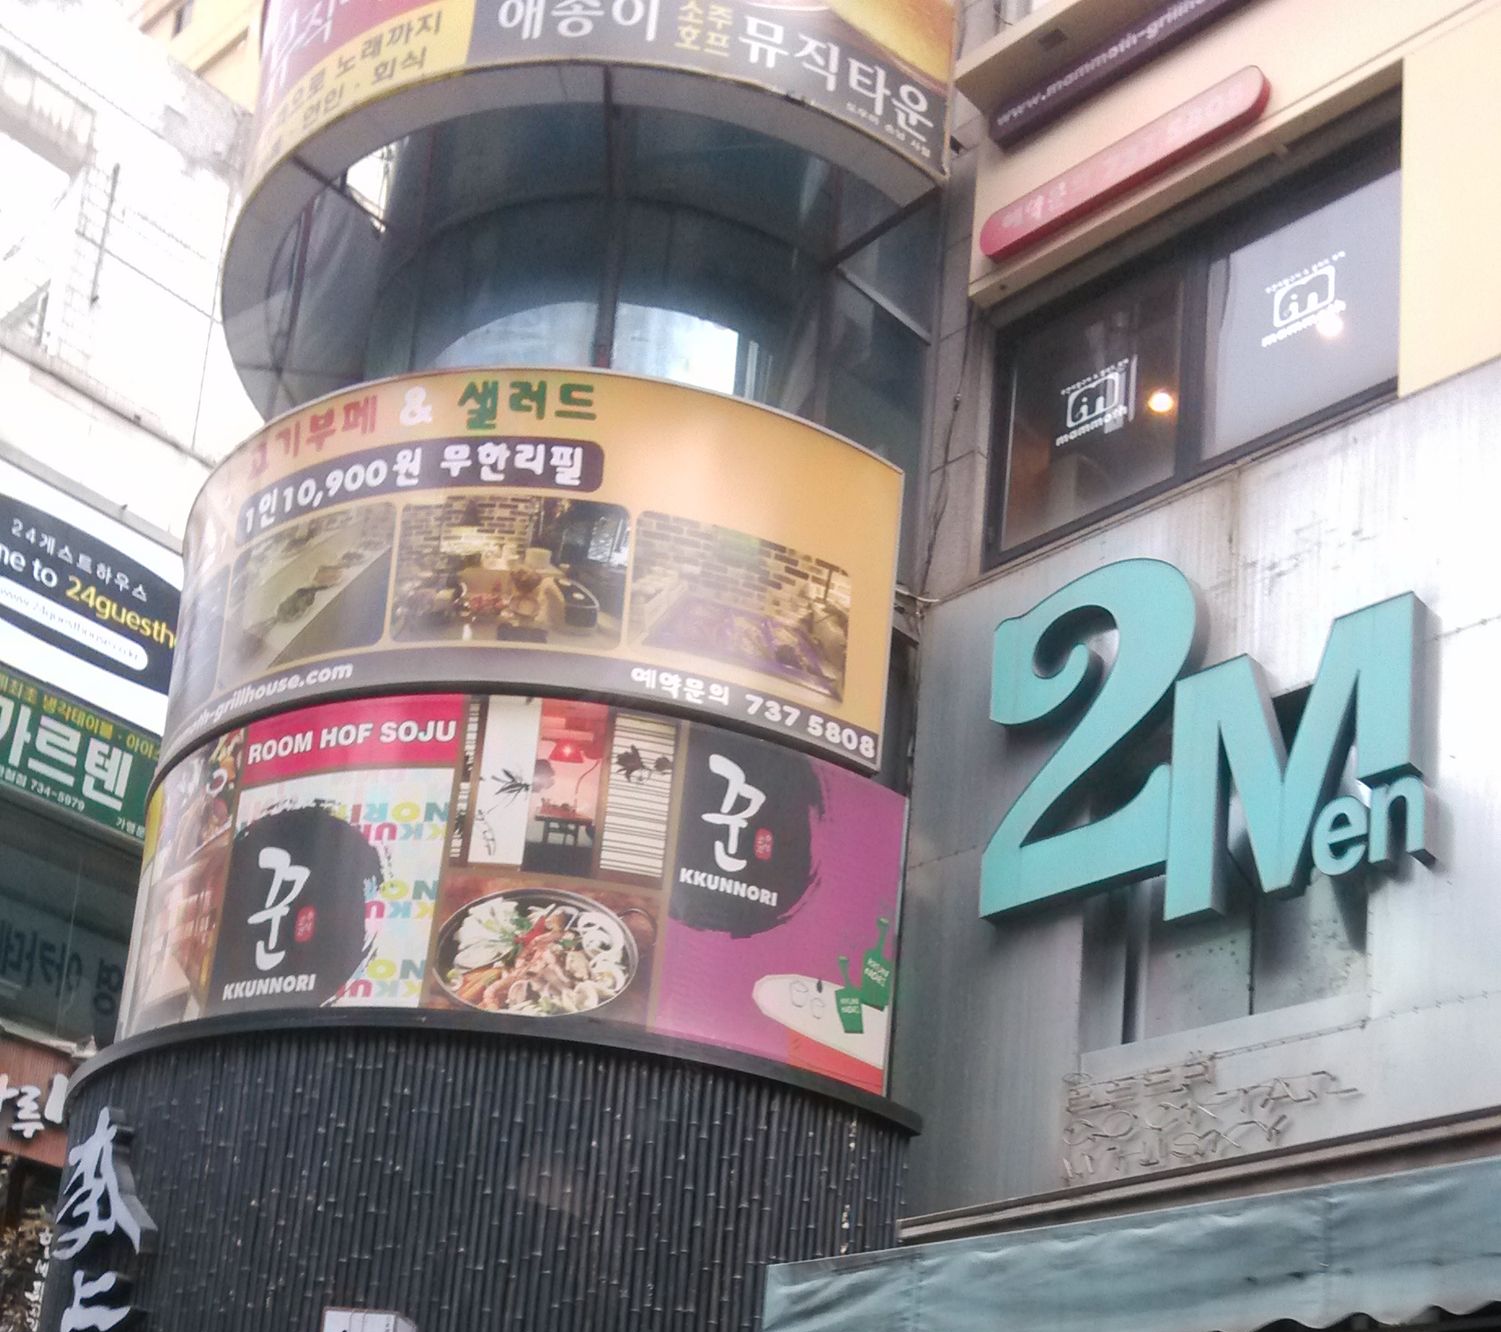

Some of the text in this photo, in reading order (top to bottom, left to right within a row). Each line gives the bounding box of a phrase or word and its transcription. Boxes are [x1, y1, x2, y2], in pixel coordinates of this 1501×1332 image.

[334, 10, 443, 78] 노래까지
[499, 0, 660, 42] 애송이
[371, 46, 427, 84] 회식
[739, 15, 934, 142] 뮤직타운
[399, 385, 433, 427] &
[457, 380, 597, 431] 샐러드
[440, 442, 585, 487] 무한리필
[11, 517, 148, 603] 24게스트하우스
[32, 557, 58, 589] to
[65, 574, 178, 650] 24guesth
[630, 666, 876, 759] 예약문의 737 5808
[247, 719, 457, 766] ROOM HOF SOJU
[679, 866, 778, 908] KKUNNORI
[222, 973, 316, 1001] KKUNNORI
